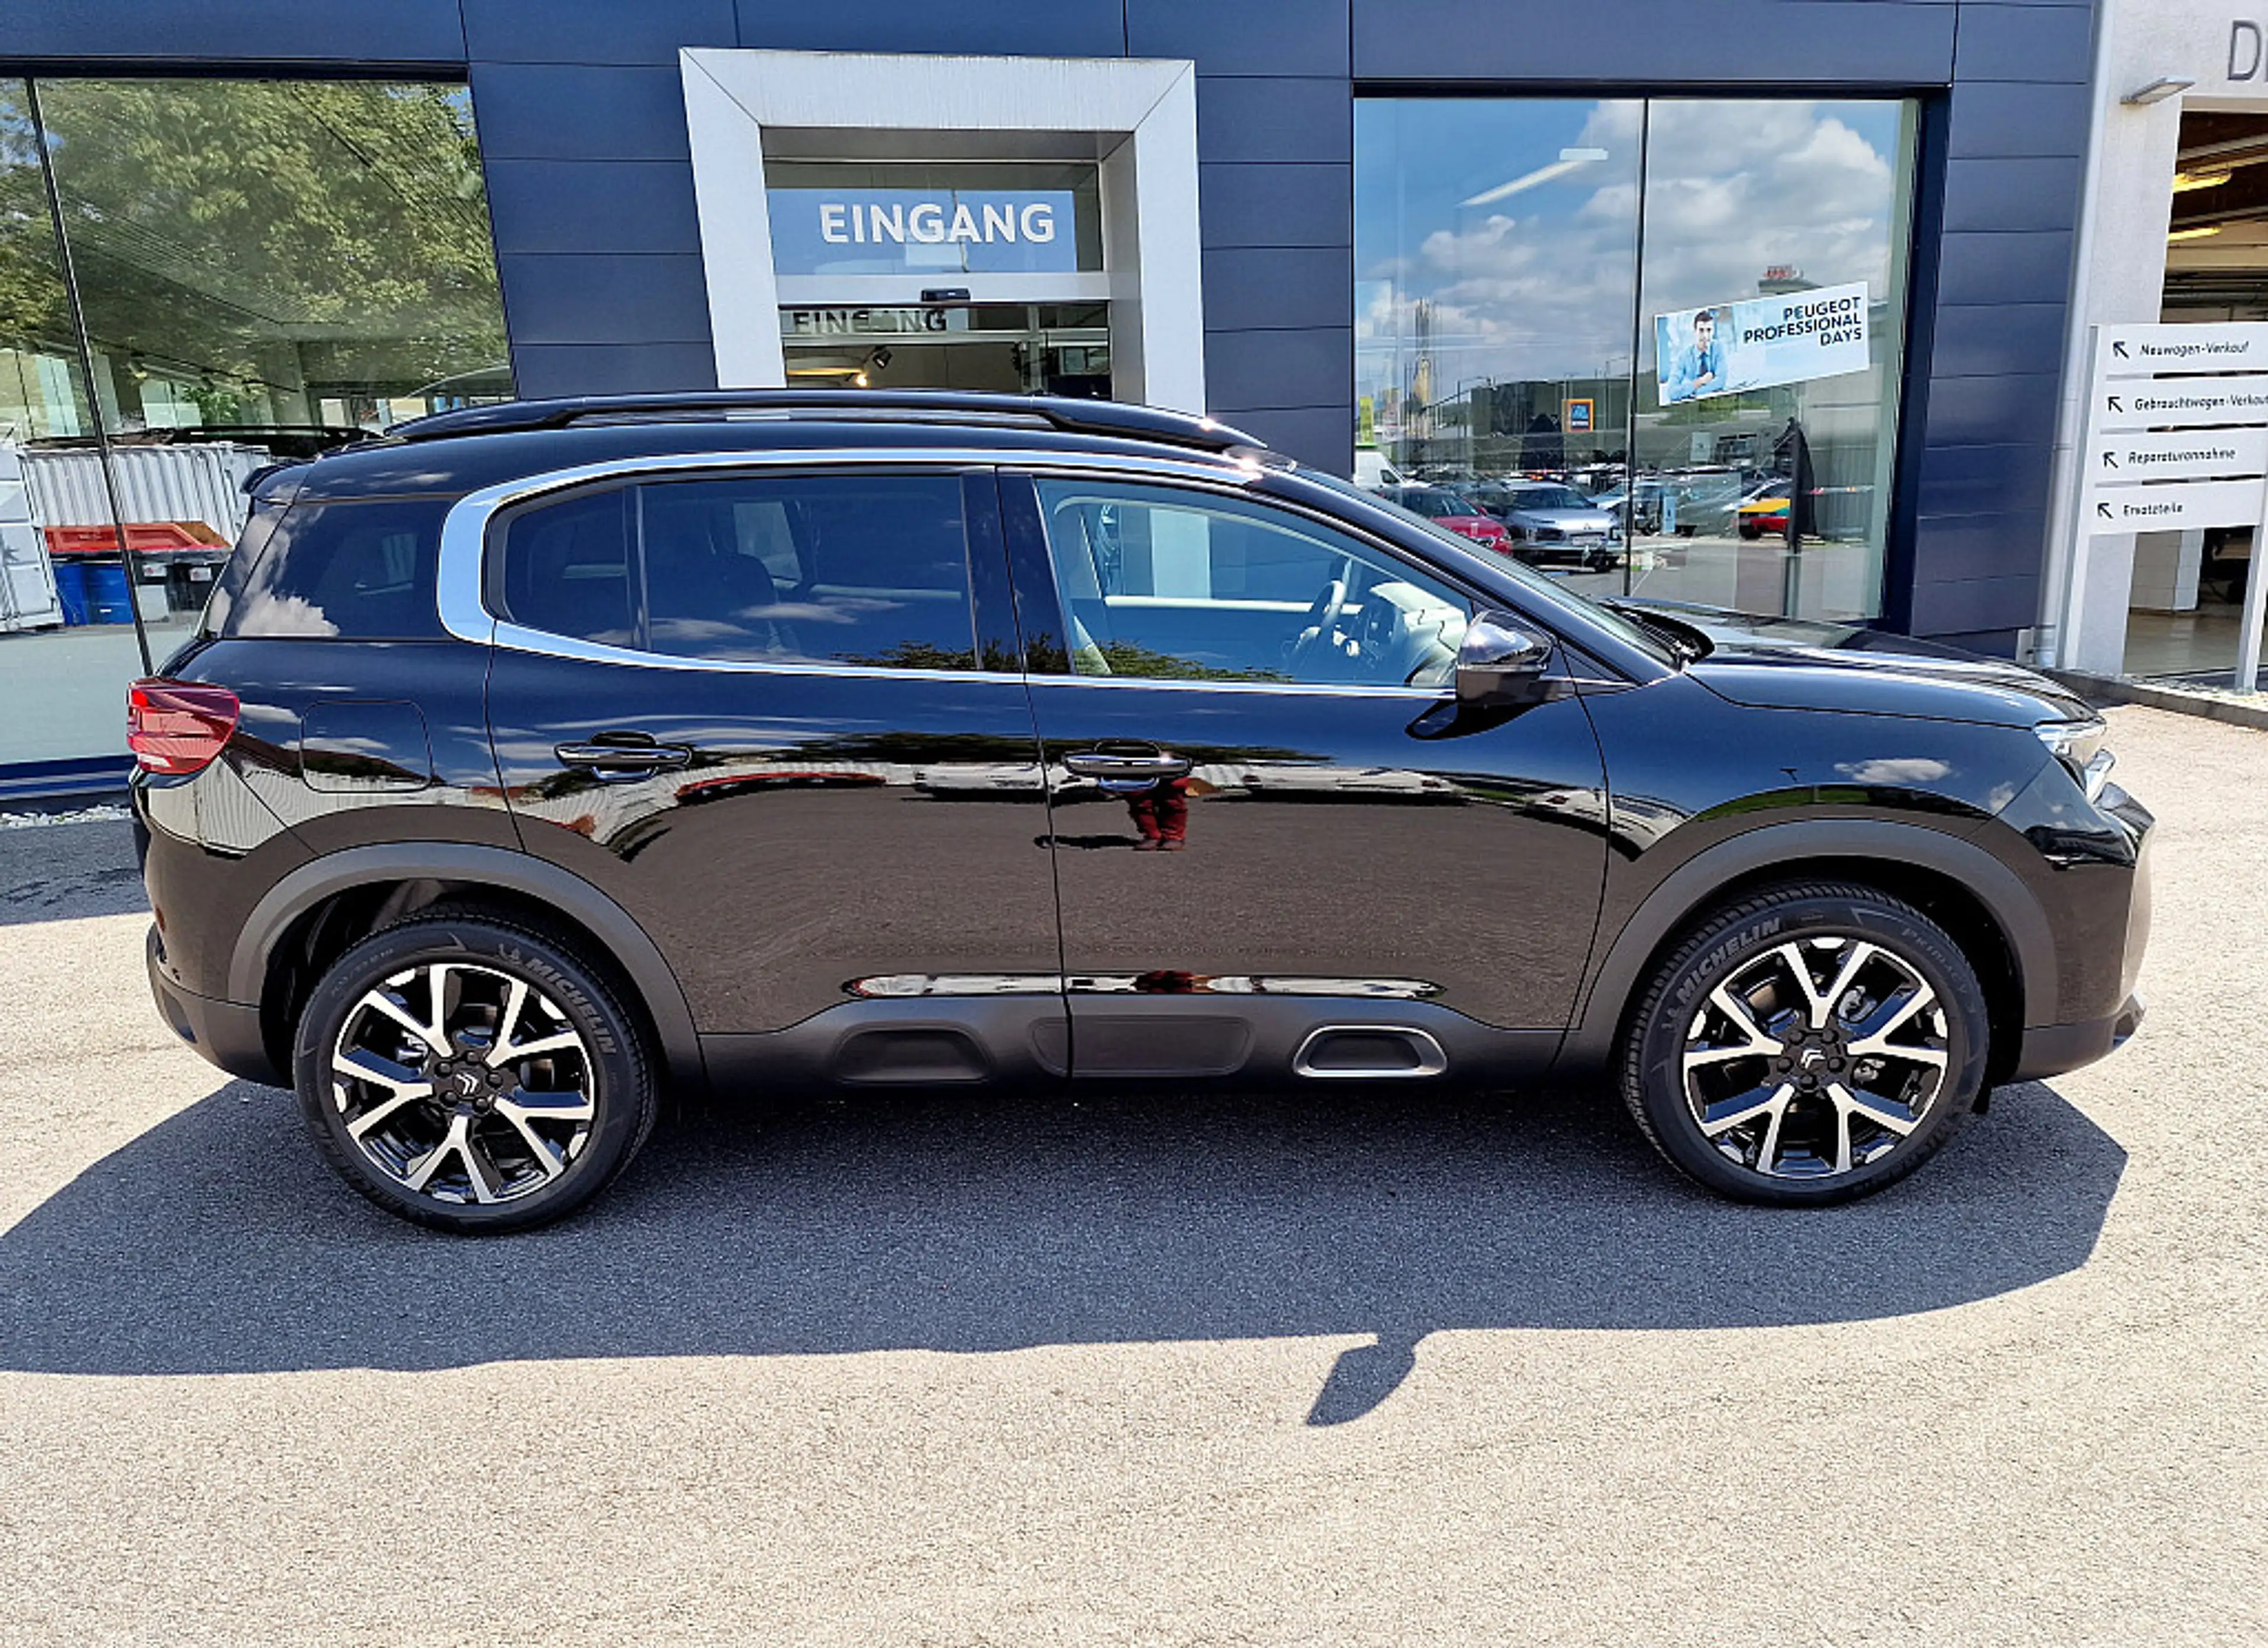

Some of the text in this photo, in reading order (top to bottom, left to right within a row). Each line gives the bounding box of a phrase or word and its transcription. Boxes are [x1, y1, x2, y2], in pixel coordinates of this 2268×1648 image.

[2227, 20, 2268, 82] D
[819, 203, 1054, 243] EINGANG
[1783, 297, 1861, 321] PEUGEOT
[1743, 312, 1862, 344] PROFESSIONAL
[1820, 328, 1862, 346] DAYS
[2140, 341, 2249, 357] Neuwagen-Verkauf
[2135, 394, 2268, 411] Gebrauchtwagen-Verkau
[2128, 447, 2236, 464] Reparaturannahme
[2123, 502, 2184, 517] Ersatzteile
[1676, 917, 1780, 1004] MICHELIN
[526, 957, 617, 1053] MICHELIN
